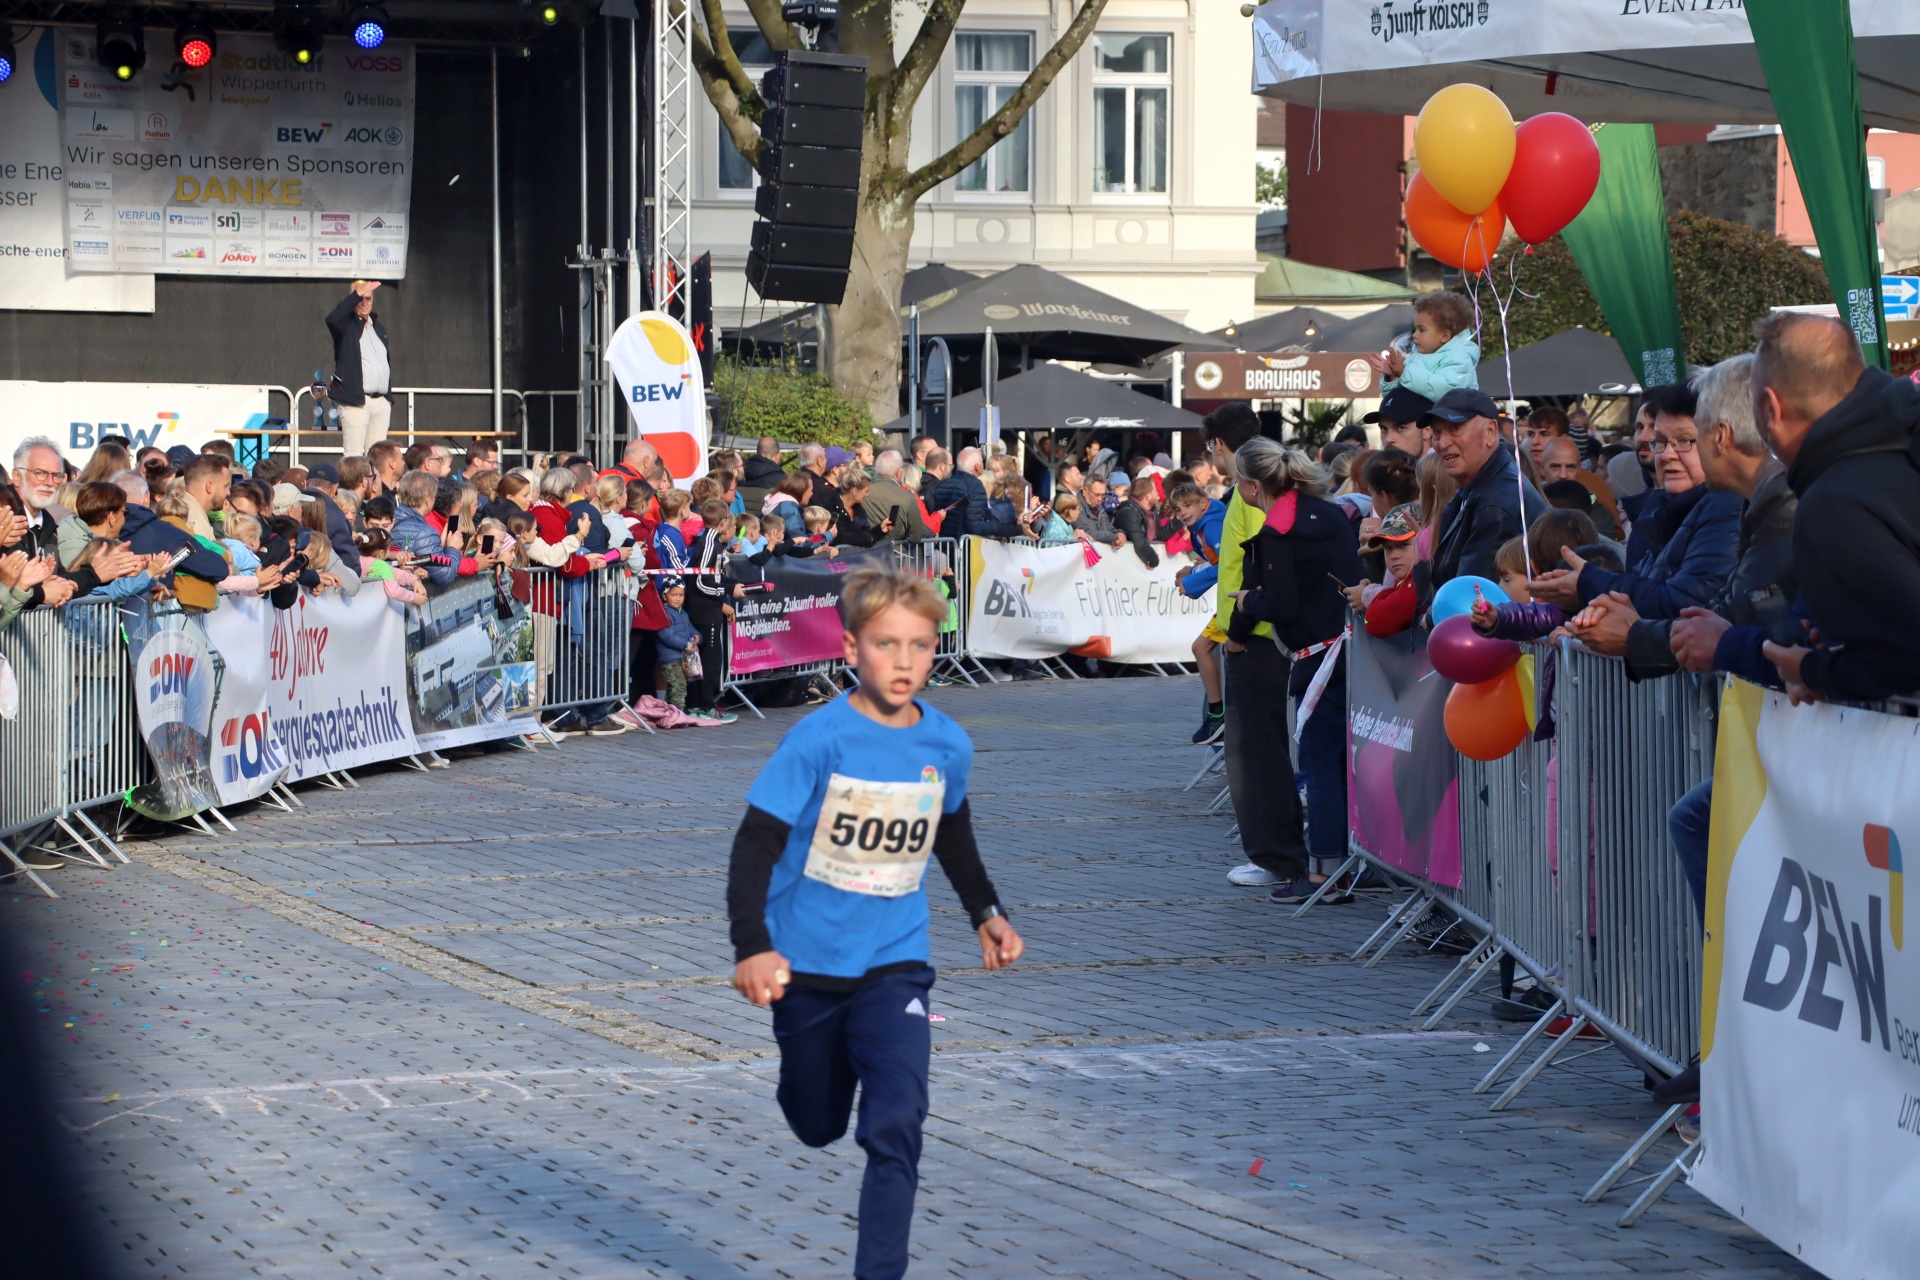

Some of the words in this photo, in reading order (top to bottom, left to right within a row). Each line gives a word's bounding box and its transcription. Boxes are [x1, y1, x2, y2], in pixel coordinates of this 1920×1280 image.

[346, 55, 403, 73] VOSS
[357, 94, 402, 107] Helios
[276, 127, 324, 143] BEW
[344, 127, 383, 143] AOK
[67, 146, 106, 164] Wir
[112, 151, 182, 171] sagen
[189, 153, 279, 171] unseren
[287, 154, 404, 176] Sponsoren
[68, 180, 91, 190] Habia
[176, 174, 303, 206] DANKE
[268, 252, 306, 260] BONGEN
[329, 247, 353, 257] ONI
[1021, 303, 1131, 326] Warsteiner
[1245, 370, 1321, 391] BRAUHAUS
[632, 382, 684, 403] BEW
[70, 422, 162, 449] BEW
[760, 598, 783, 615] eine
[783, 594, 815, 613] Zukunft
[815, 592, 840, 608] voller
[1104, 579, 1142, 617] hier.
[1147, 578, 1177, 616] Für
[288, 594, 328, 701] Jahre
[830, 812, 929, 854] 5099
[1742, 856, 1892, 1053] BEW
